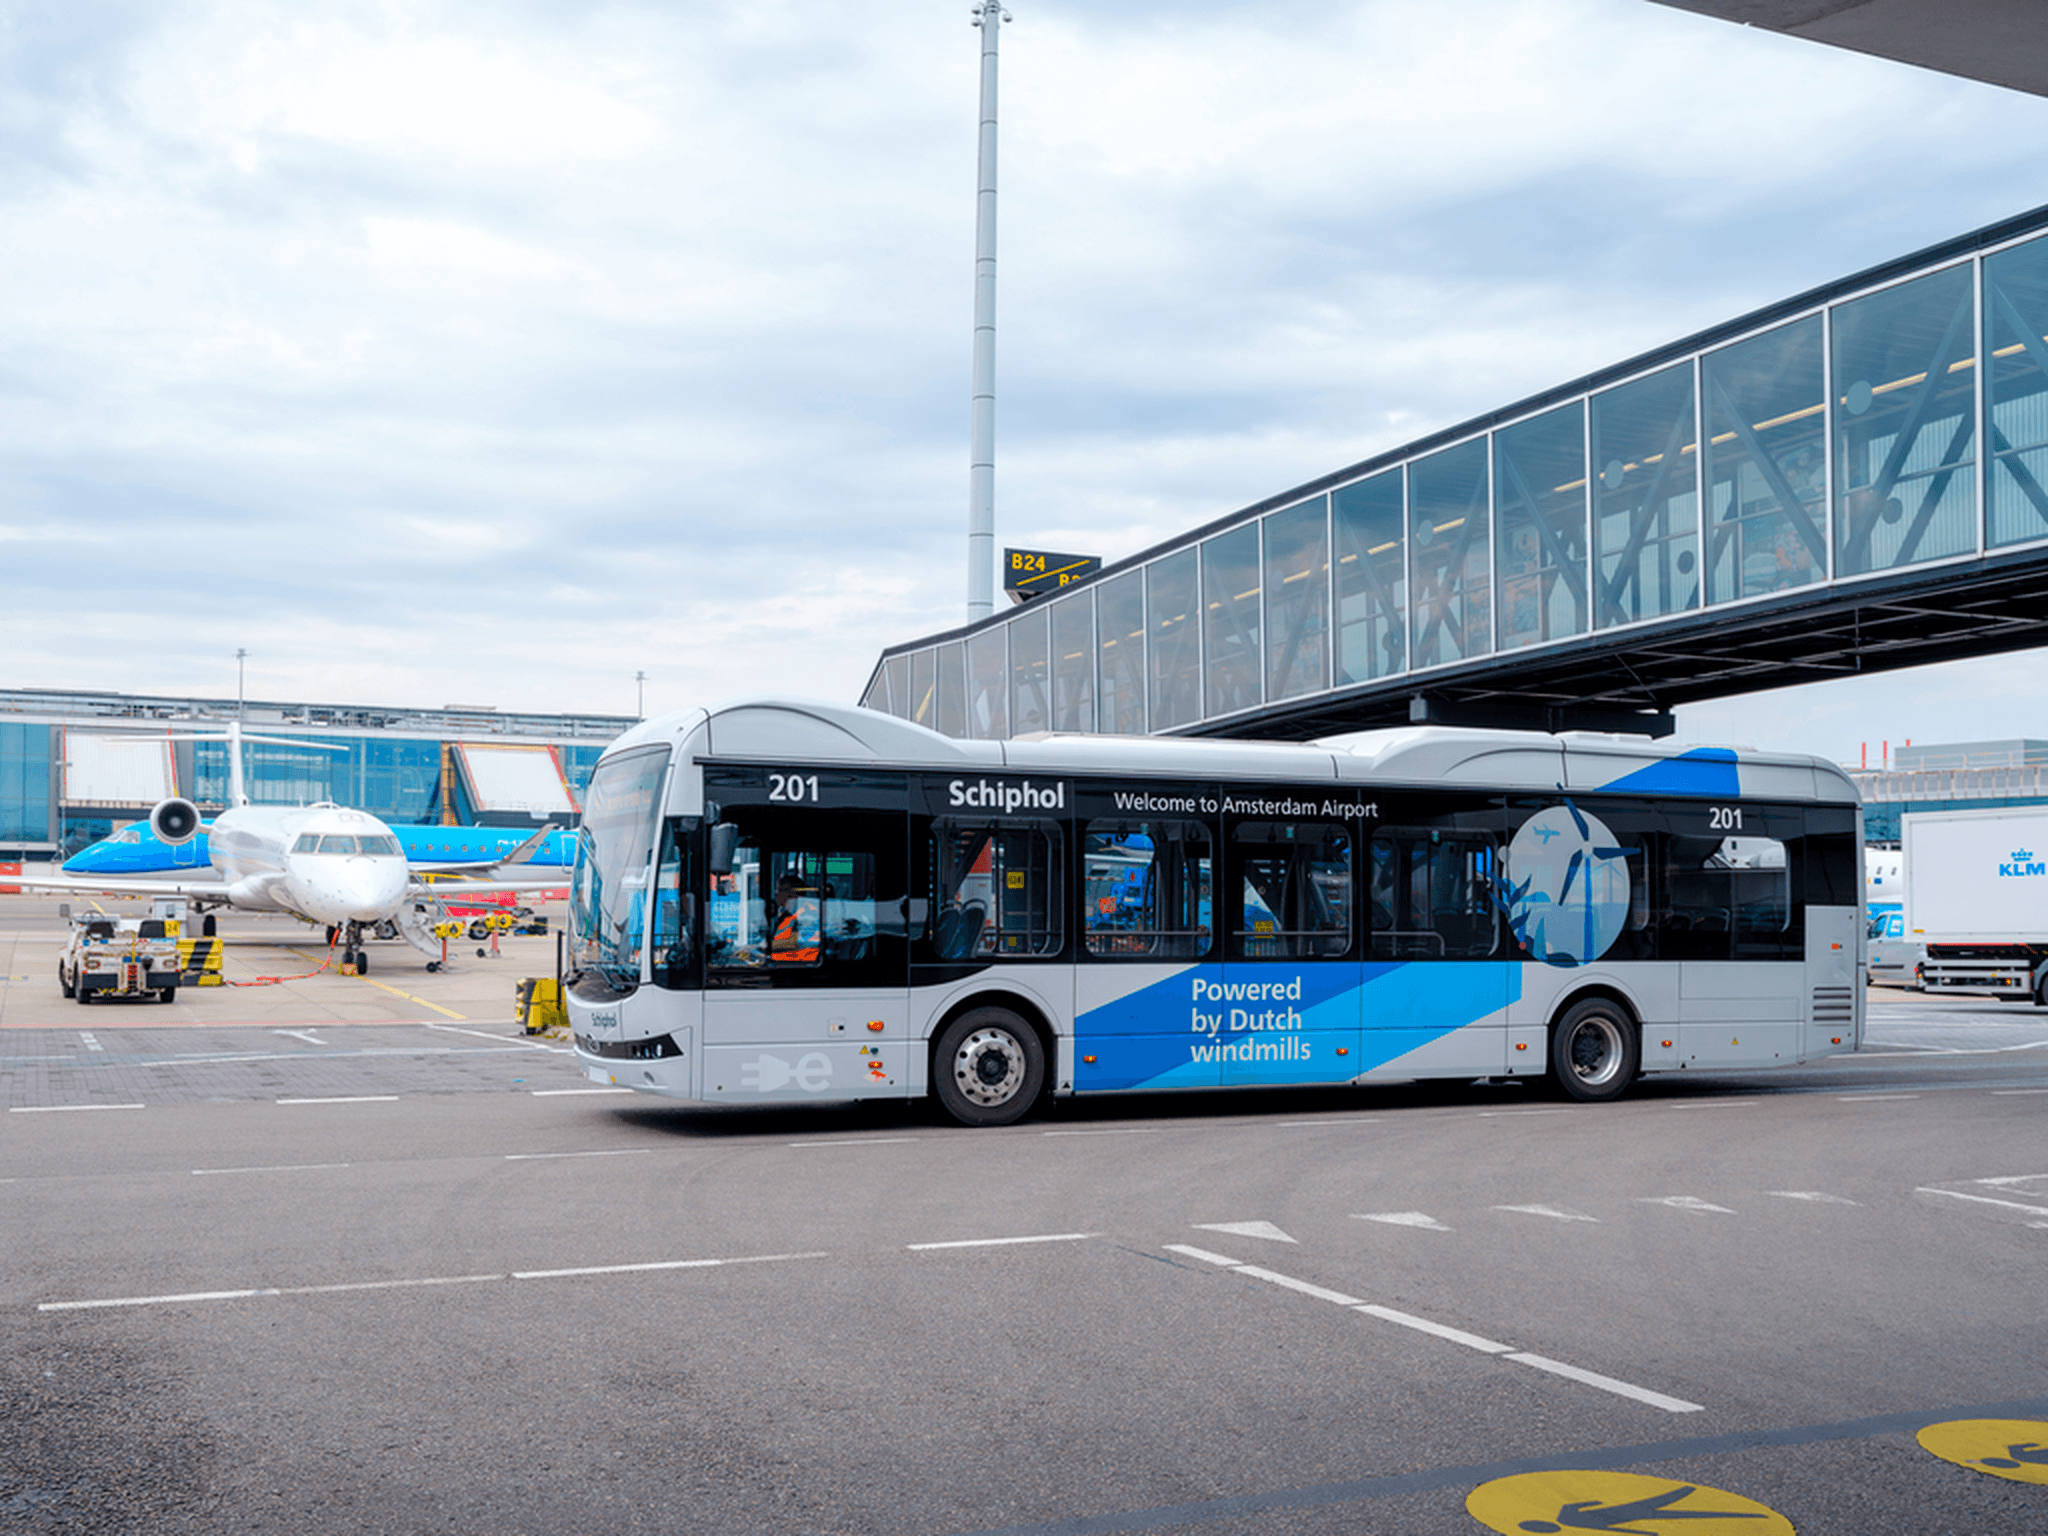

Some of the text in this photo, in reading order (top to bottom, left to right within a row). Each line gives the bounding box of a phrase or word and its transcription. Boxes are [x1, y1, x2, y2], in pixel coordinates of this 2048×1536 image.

[1012, 553, 1045, 571] B24
[768, 774, 819, 802] 201
[949, 779, 1065, 814] Schiphol
[1114, 792, 1379, 820] Welcome to Amsterdam Airport
[1708, 806, 1742, 829] 201
[1999, 863, 2046, 876] KLM
[1192, 976, 1302, 1001] Powered
[1191, 1006, 1303, 1038] by Dutch
[1190, 1036, 1311, 1063] windmills
